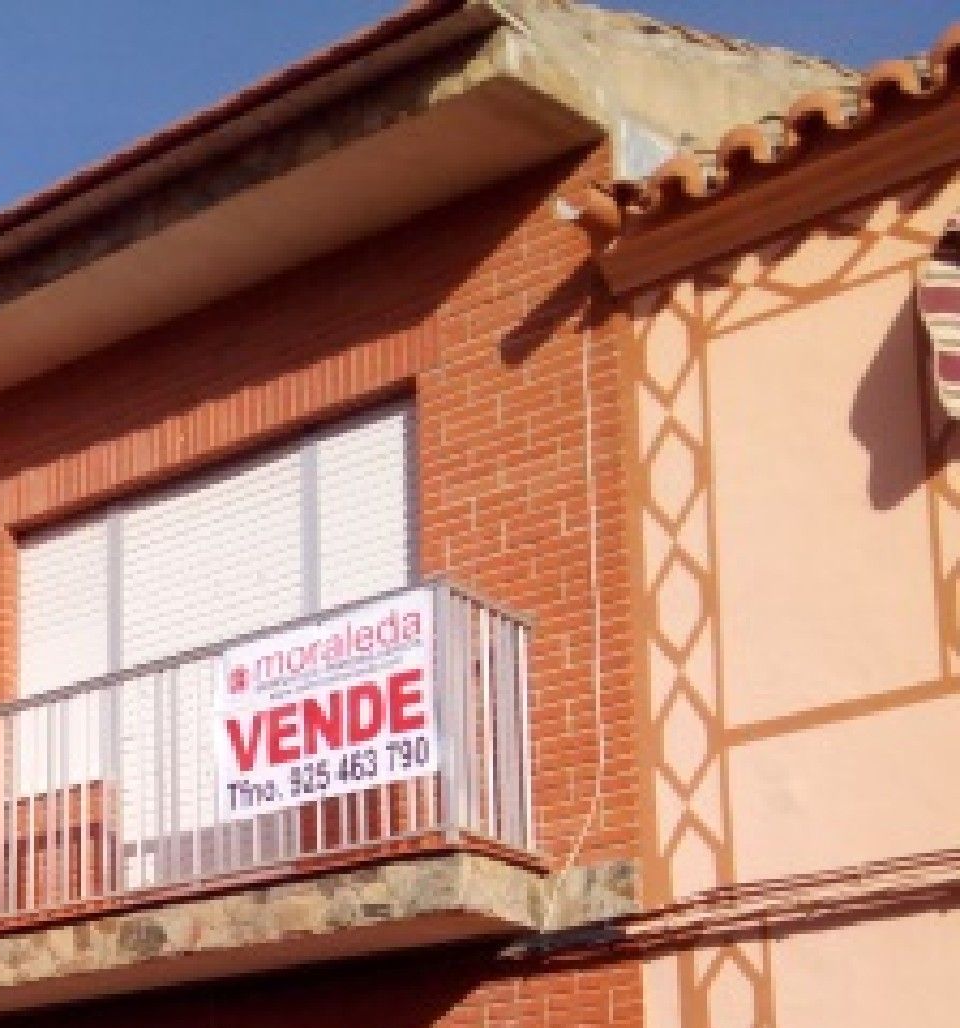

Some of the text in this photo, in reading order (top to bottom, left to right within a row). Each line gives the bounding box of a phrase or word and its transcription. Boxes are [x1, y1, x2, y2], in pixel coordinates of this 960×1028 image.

[256, 610, 421, 678] moraleda
[225, 668, 426, 772] VENDE
[290, 758, 331, 798] 925
[335, 747, 378, 781] 463
[386, 736, 430, 772] 790
